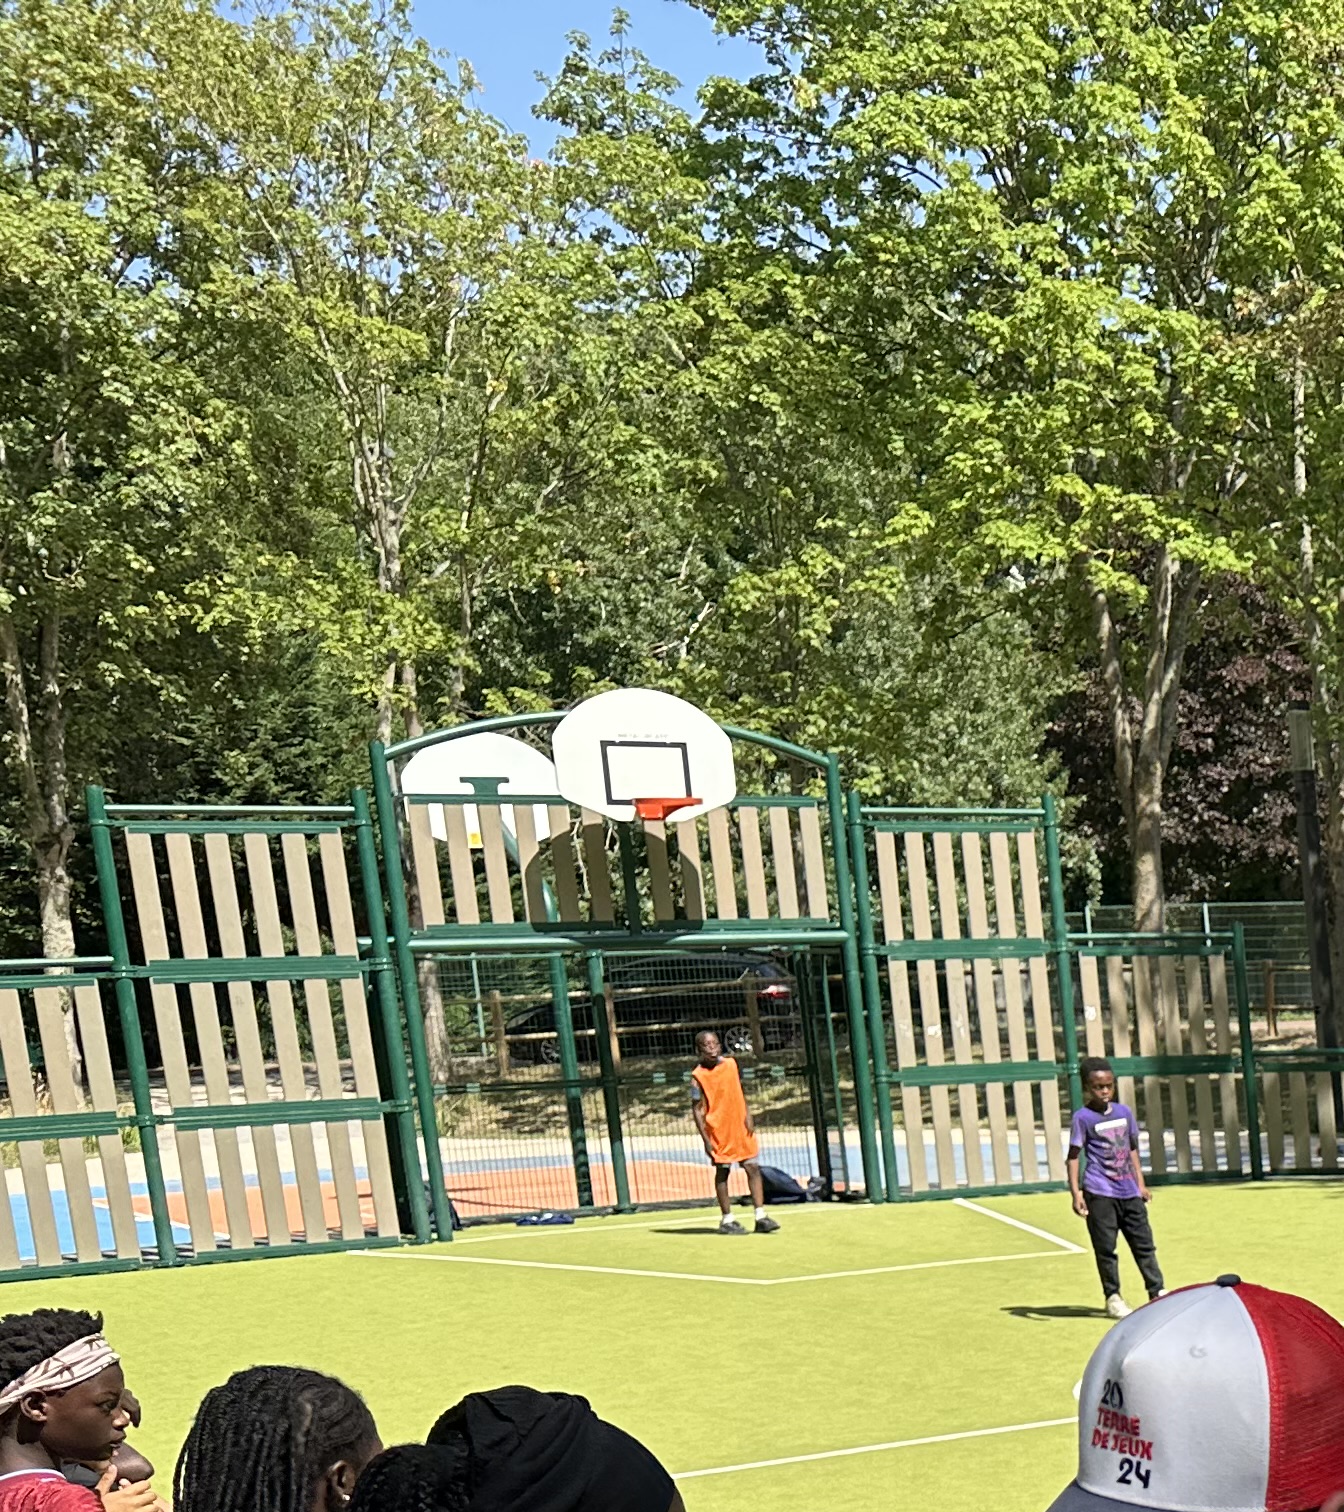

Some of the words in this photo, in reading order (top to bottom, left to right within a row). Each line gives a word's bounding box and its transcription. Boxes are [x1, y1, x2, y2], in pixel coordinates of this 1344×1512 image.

[1101, 1378, 1124, 1409] 20
[1097, 1407, 1141, 1436] TERRE
[1091, 1427, 1111, 1450] DE
[1111, 1434, 1154, 1461] JEUX
[1116, 1457, 1151, 1489] 24
